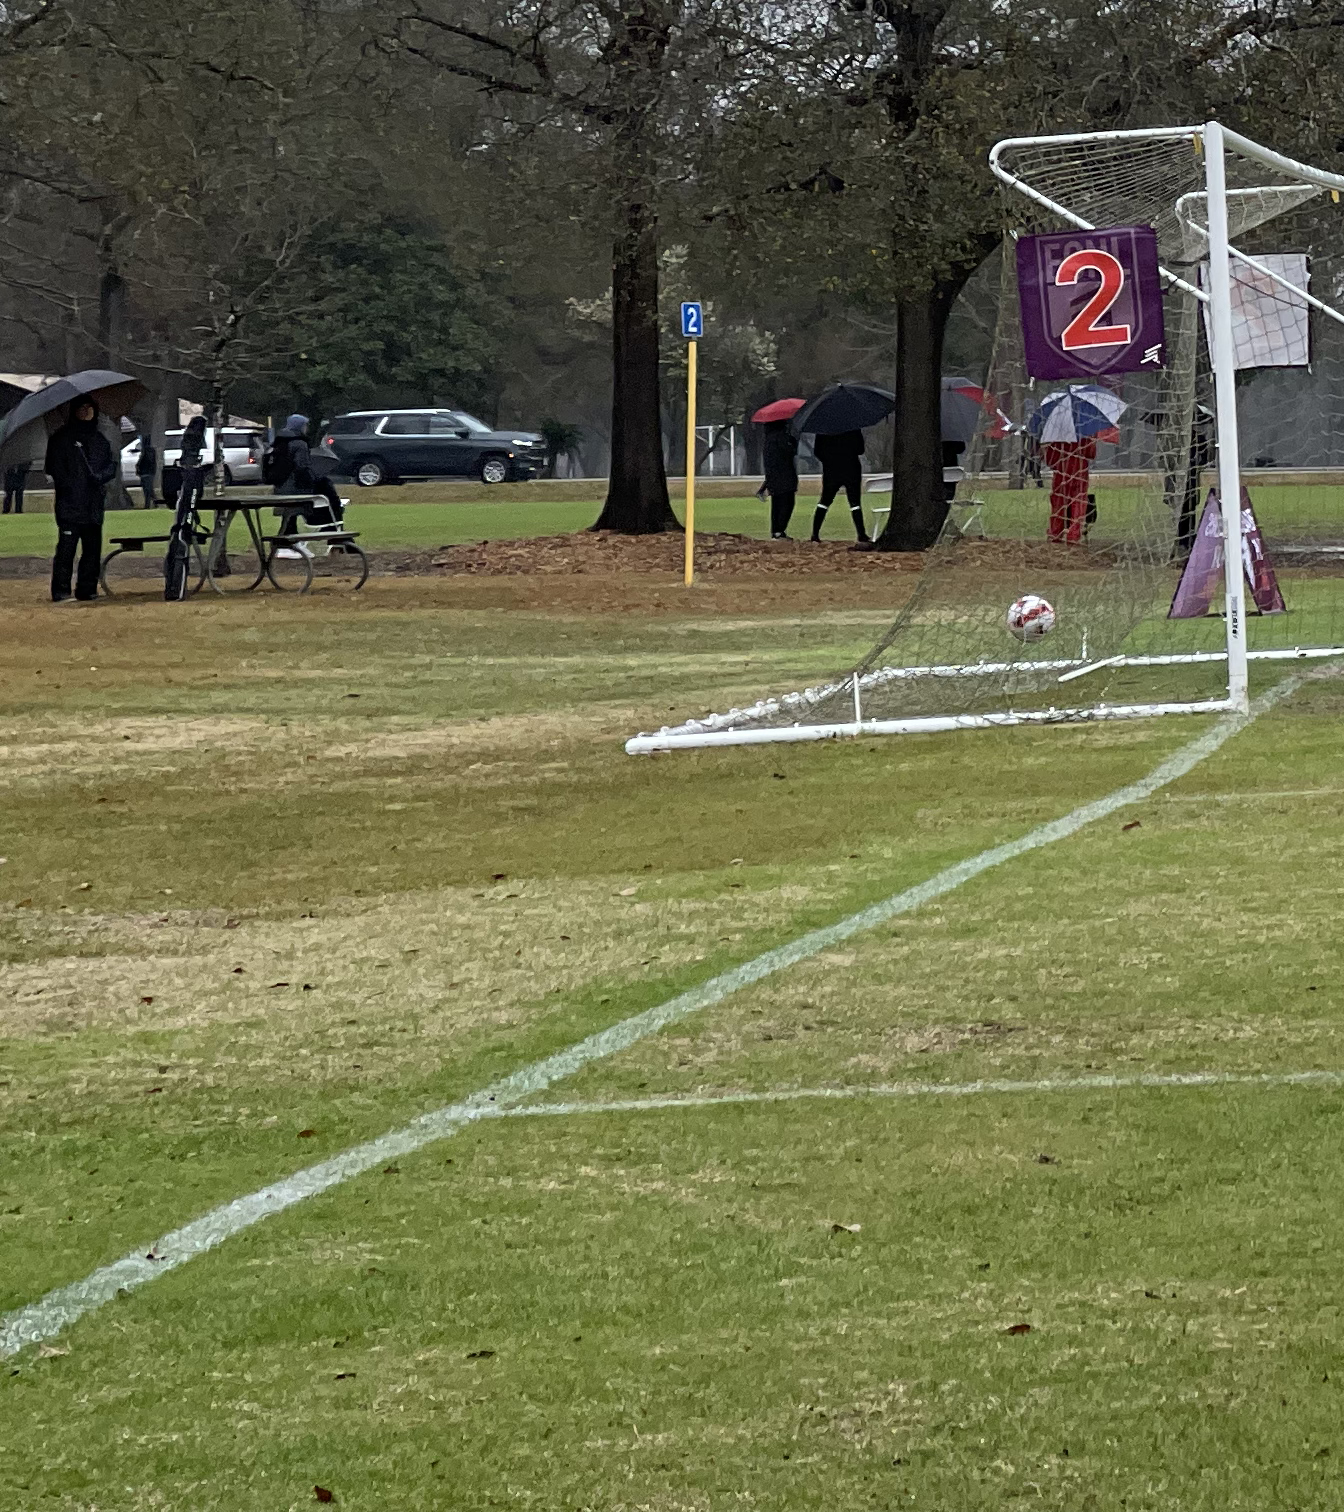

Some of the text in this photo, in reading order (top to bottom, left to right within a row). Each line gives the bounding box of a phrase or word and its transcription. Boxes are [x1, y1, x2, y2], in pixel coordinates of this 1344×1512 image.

[1043, 236, 1131, 284] EL
[687, 307, 698, 332] 2
[1055, 249, 1131, 350] 2
